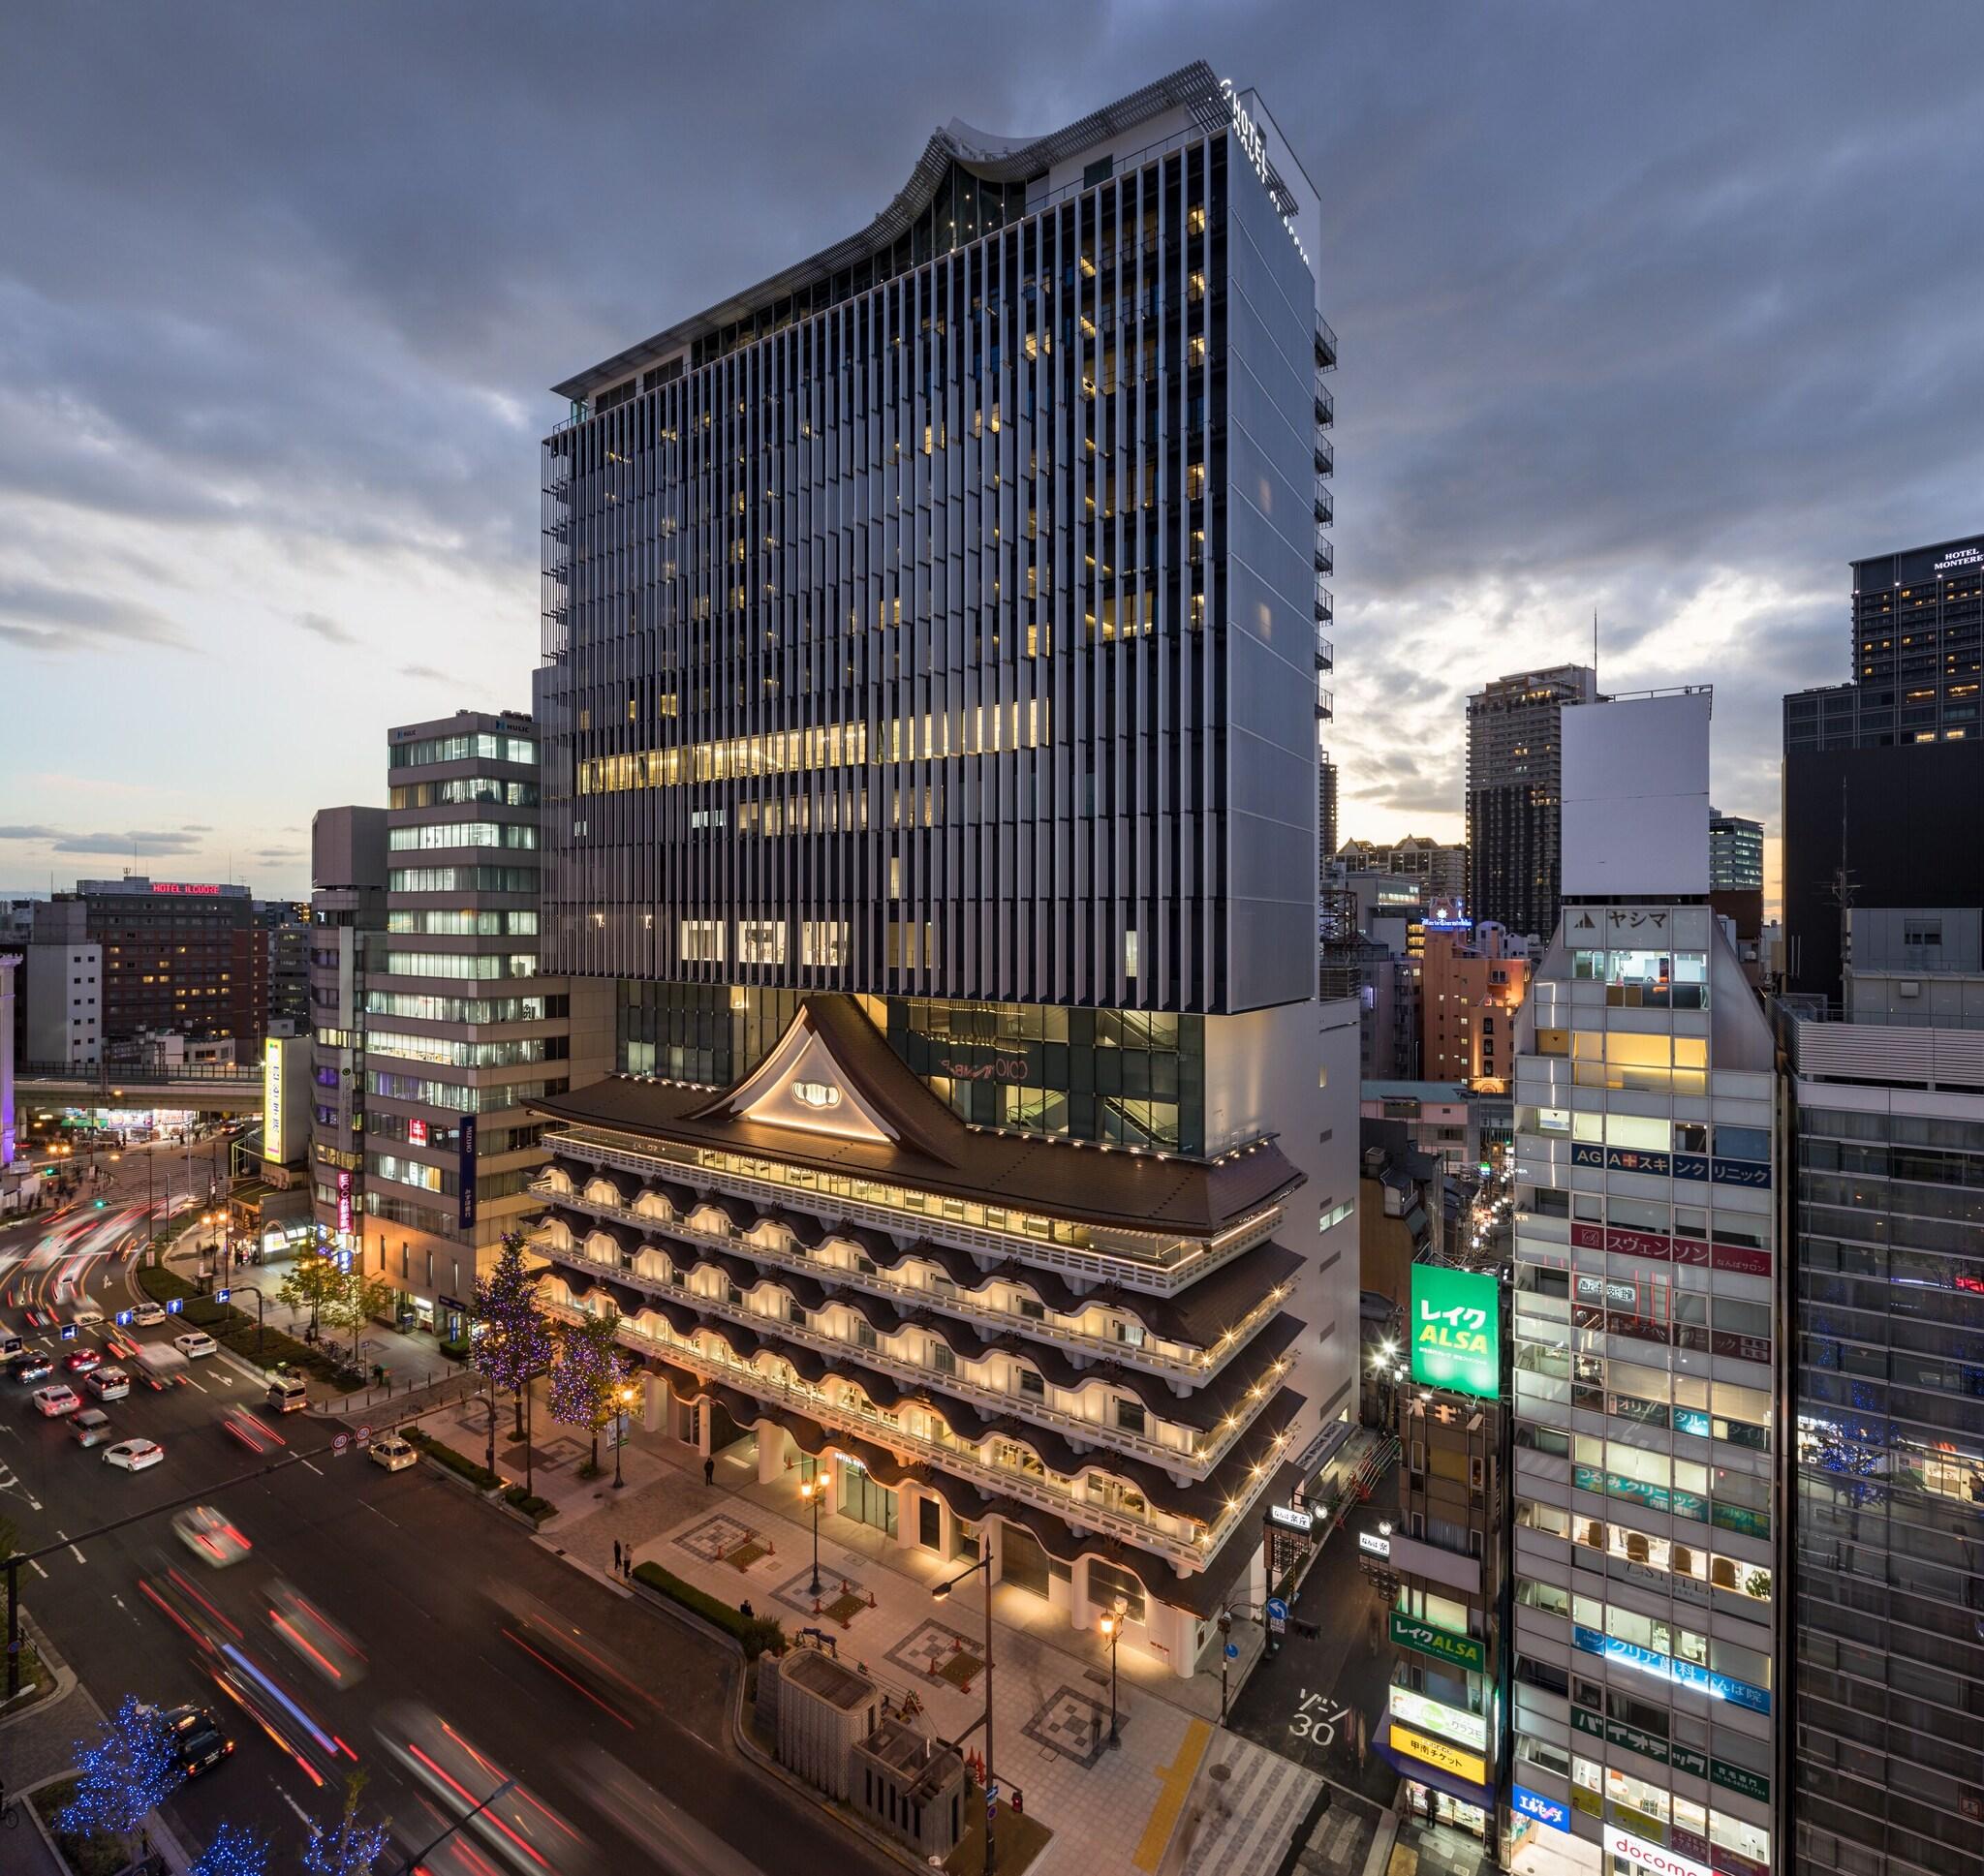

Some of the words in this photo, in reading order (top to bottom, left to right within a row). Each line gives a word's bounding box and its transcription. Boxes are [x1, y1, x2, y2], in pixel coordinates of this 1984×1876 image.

[1233, 93, 1268, 176] HOTEL
[1934, 554, 1984, 570] MONTERE
[1944, 548, 1979, 561] HOTEL
[153, 883, 181, 893] HOTEL
[1609, 910, 1667, 929] ヤシマ
[1607, 1234, 1708, 1262] スヴェンソン
[1420, 1300, 1487, 1330] レイク
[1418, 1324, 1488, 1354] ALSA
[1288, 1713, 1335, 1746] 30
[1578, 1713, 1706, 1774] バイオテック
[1410, 1738, 1463, 1768] 甲南チケット
